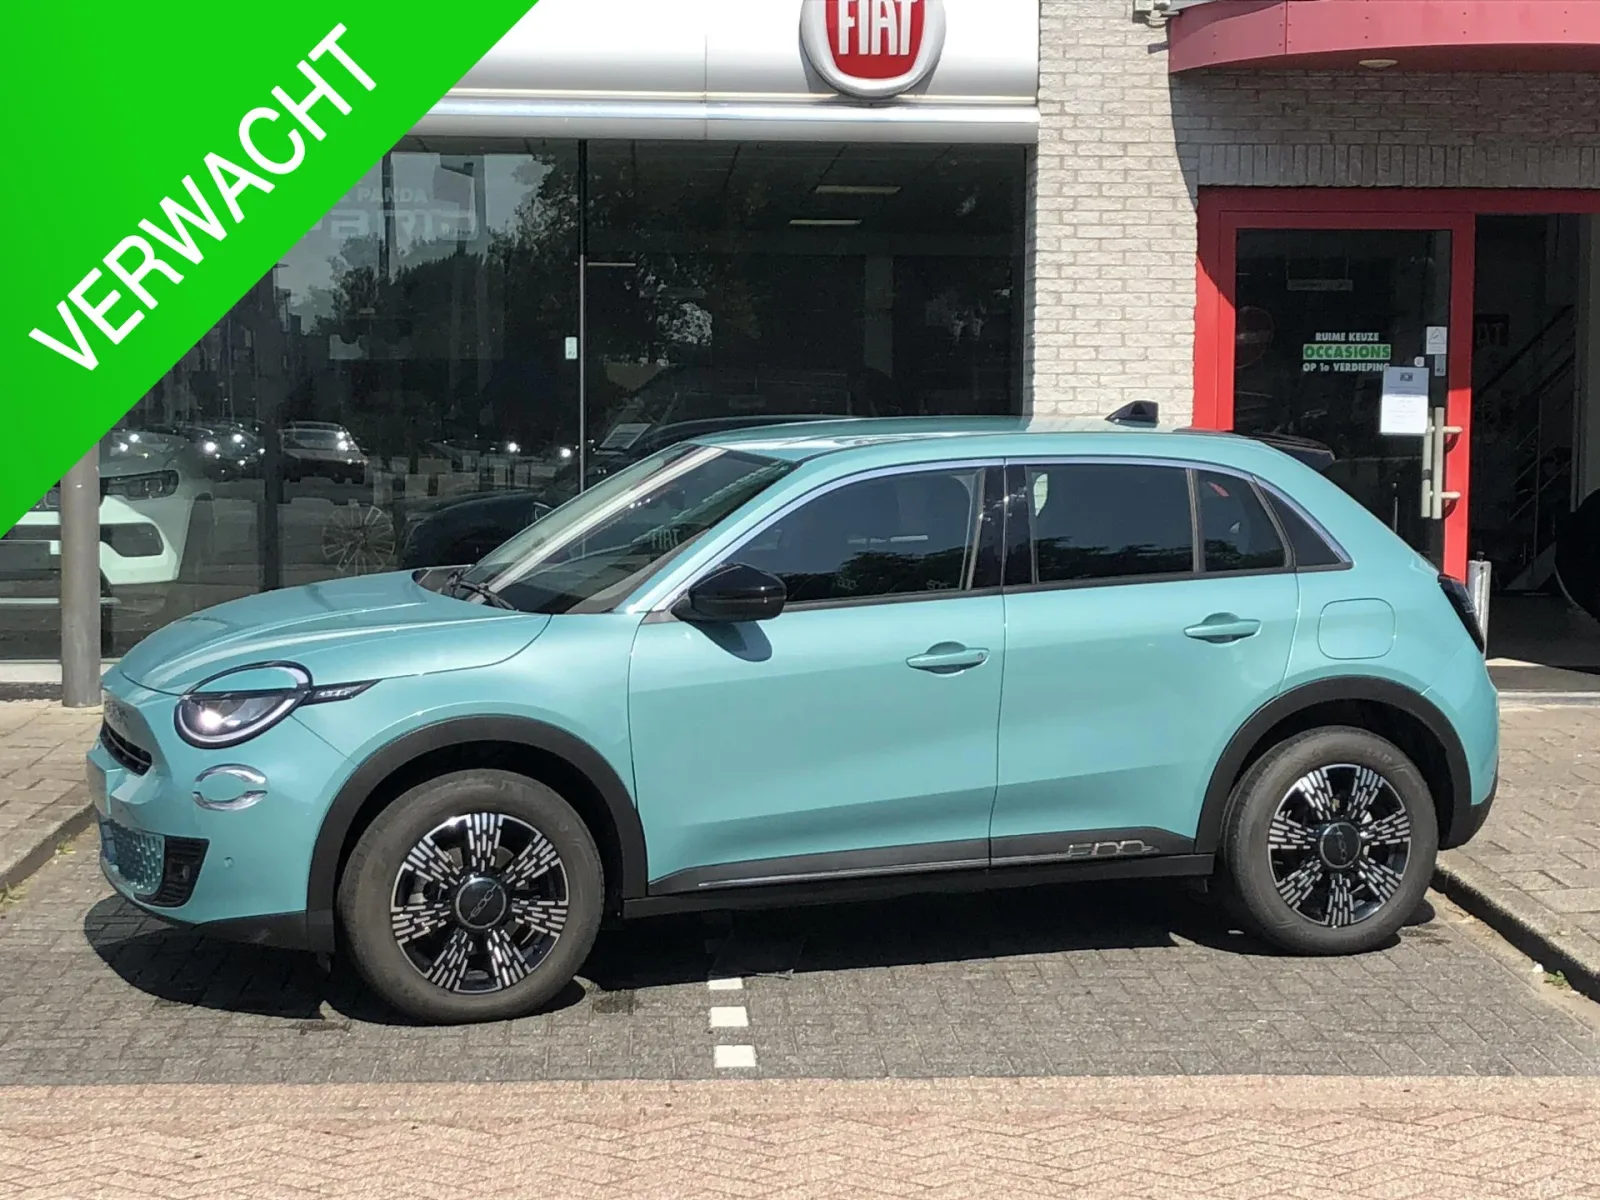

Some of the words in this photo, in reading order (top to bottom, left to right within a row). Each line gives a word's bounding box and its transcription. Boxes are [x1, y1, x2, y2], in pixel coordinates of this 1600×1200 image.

[838, 0, 917, 55] FIAT
[1315, 332, 1346, 342] RUIME
[1348, 332, 1380, 342] KEUZE
[1304, 345, 1390, 359] OCCASIONS
[1302, 362, 1317, 372] OP
